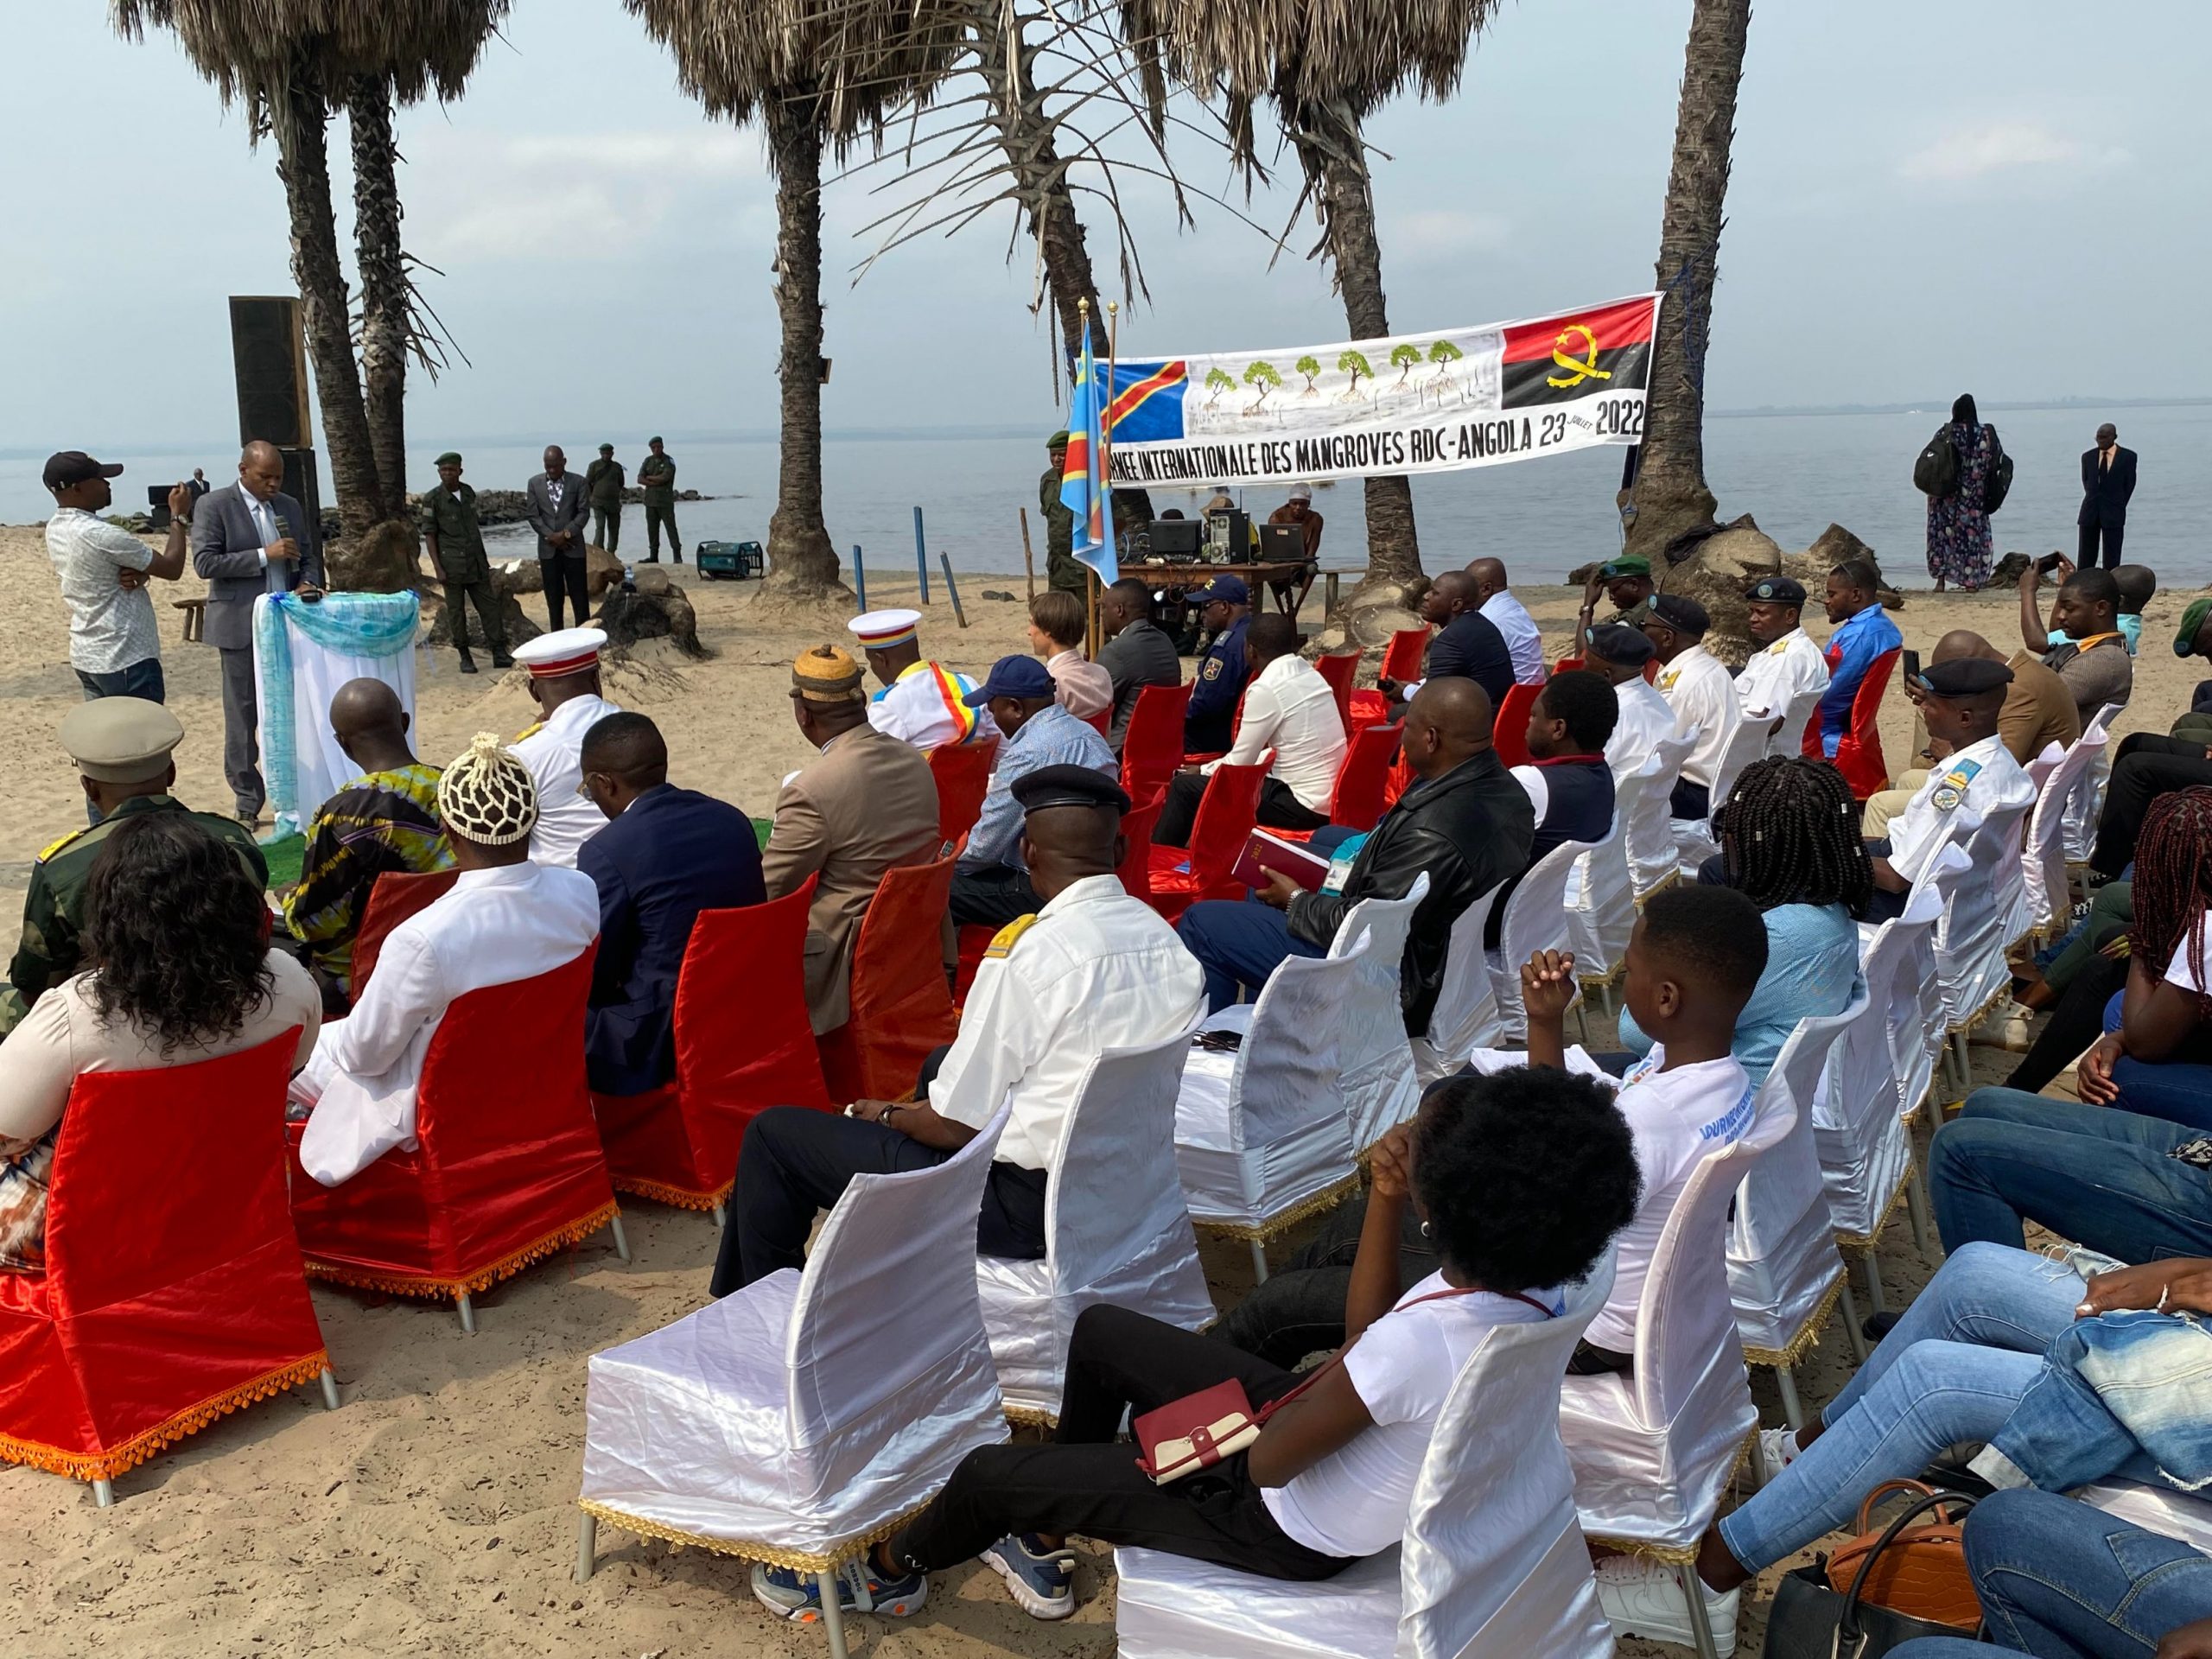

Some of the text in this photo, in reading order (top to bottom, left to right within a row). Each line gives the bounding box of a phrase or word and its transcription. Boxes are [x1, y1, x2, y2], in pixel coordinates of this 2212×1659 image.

[1109, 399, 1644, 481] RNEE INTERNATIONALE DES MANGROVES RDC-ANGOLA 23 JUILLET 2022
